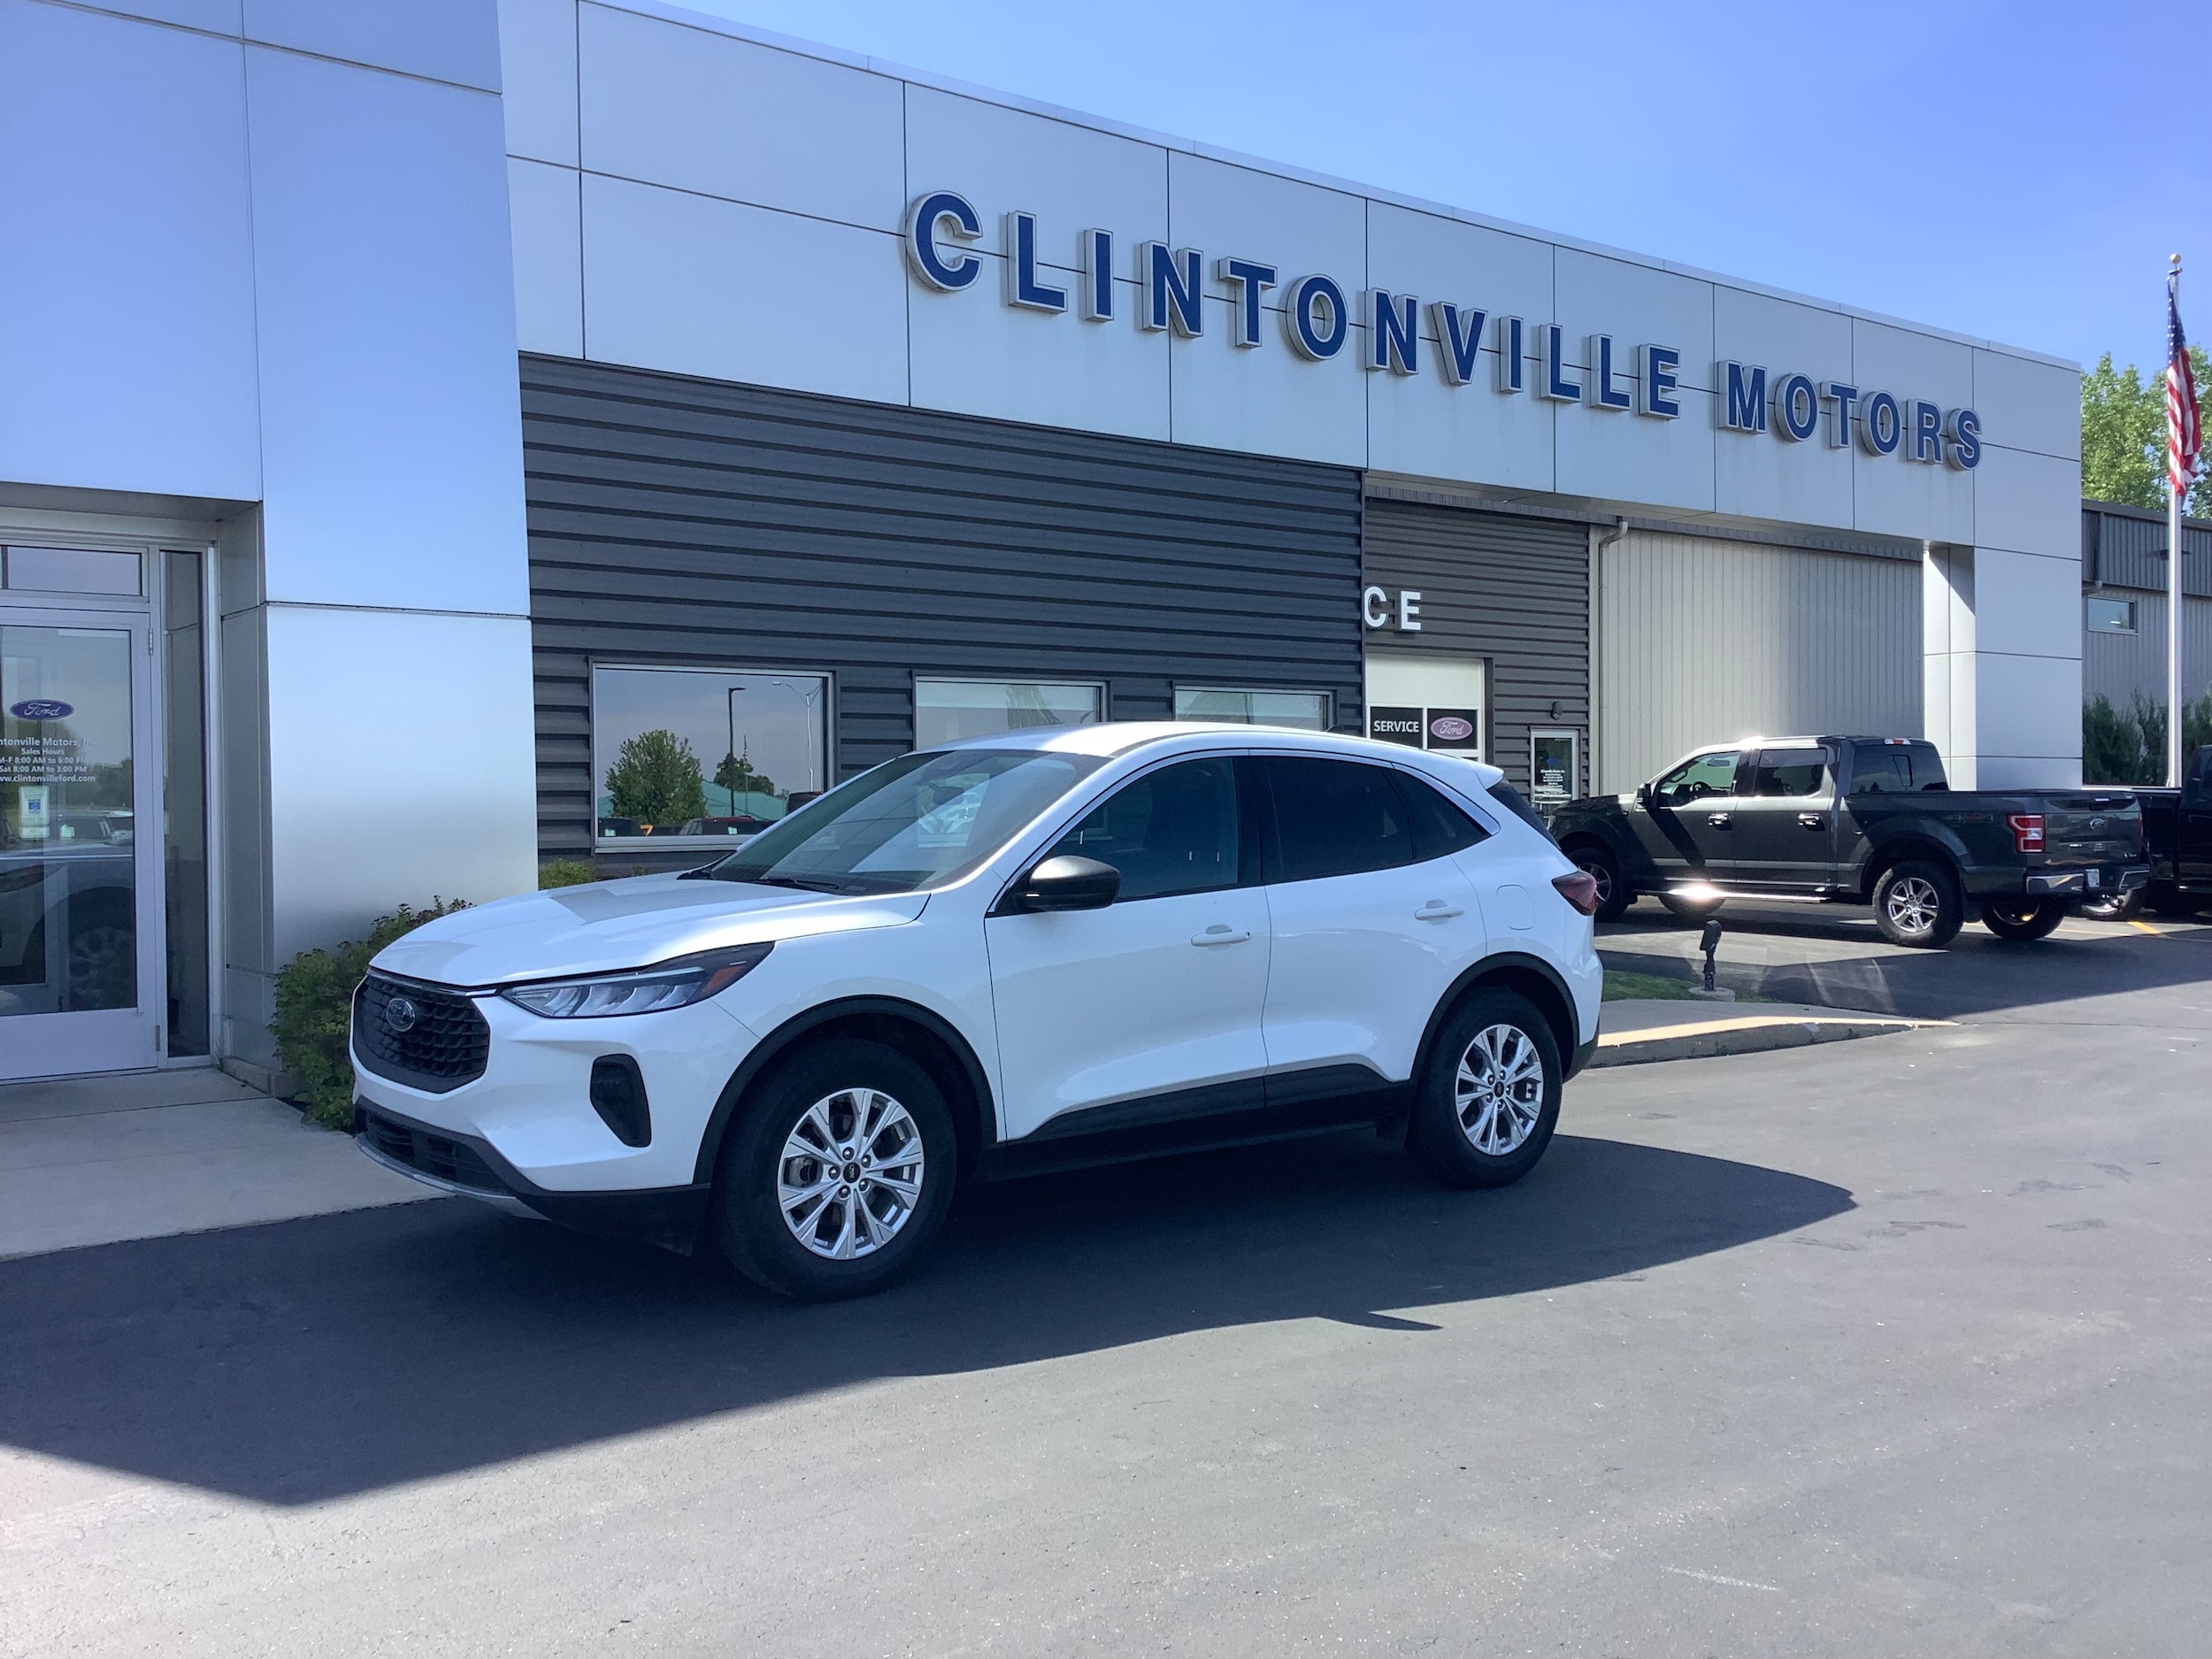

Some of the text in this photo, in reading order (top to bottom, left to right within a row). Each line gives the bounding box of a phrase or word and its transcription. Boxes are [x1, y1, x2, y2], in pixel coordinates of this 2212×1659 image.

[907, 190, 1982, 471] CLINTONVILLE MOTORS
[24, 703, 61, 717] Ford
[1373, 720, 1419, 733] SERVICE
[1440, 720, 1464, 734] Ford
[42, 738, 81, 748] Motors,
